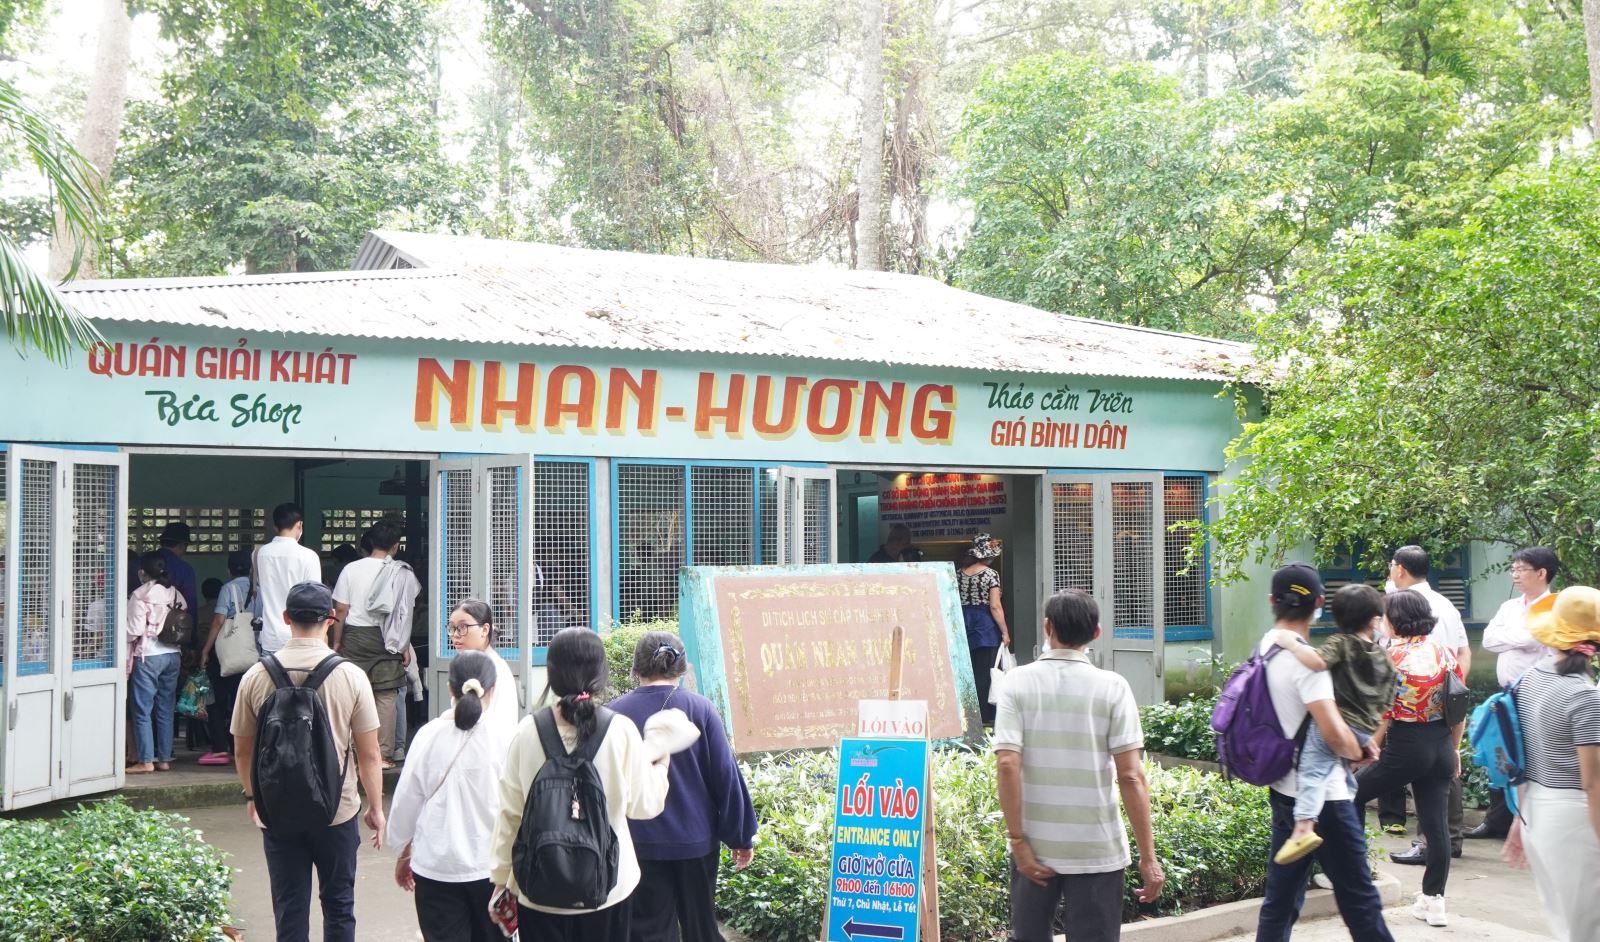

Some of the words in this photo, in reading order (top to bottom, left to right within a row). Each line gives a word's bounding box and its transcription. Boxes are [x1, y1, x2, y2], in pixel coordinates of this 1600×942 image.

[88, 337, 186, 379] QUÁN
[195, 338, 261, 382] GIẢI
[269, 347, 357, 385] KHÁT
[145, 390, 220, 427] Bia
[230, 393, 302, 434] Shop
[982, 381, 1034, 409] Thảo
[1040, 384, 1080, 411] cầm
[1087, 388, 1134, 414] Viên
[990, 415, 1027, 447] GIÁ
[1030, 417, 1080, 449] BÌNH
[1083, 419, 1128, 450] DÂN
[841, 773, 874, 818] LỐI
[879, 778, 919, 819] VÀO
[837, 826, 890, 848] ENTRANCE
[892, 829, 920, 848] ONLY
[838, 853, 862, 875] GIỜ
[863, 852, 886, 877] MỞ
[886, 854, 914, 879] CỬA
[835, 877, 862, 893] 9h00
[863, 879, 881, 895] đến
[883, 881, 915, 898] 16h00
[833, 897, 846, 907] Thứ
[848, 899, 854, 909] 7,
[856, 899, 870, 909] Chủ
[872, 900, 892, 913] Nhật,
[893, 900, 902, 912] Lễ
[904, 902, 917, 913] Tết
